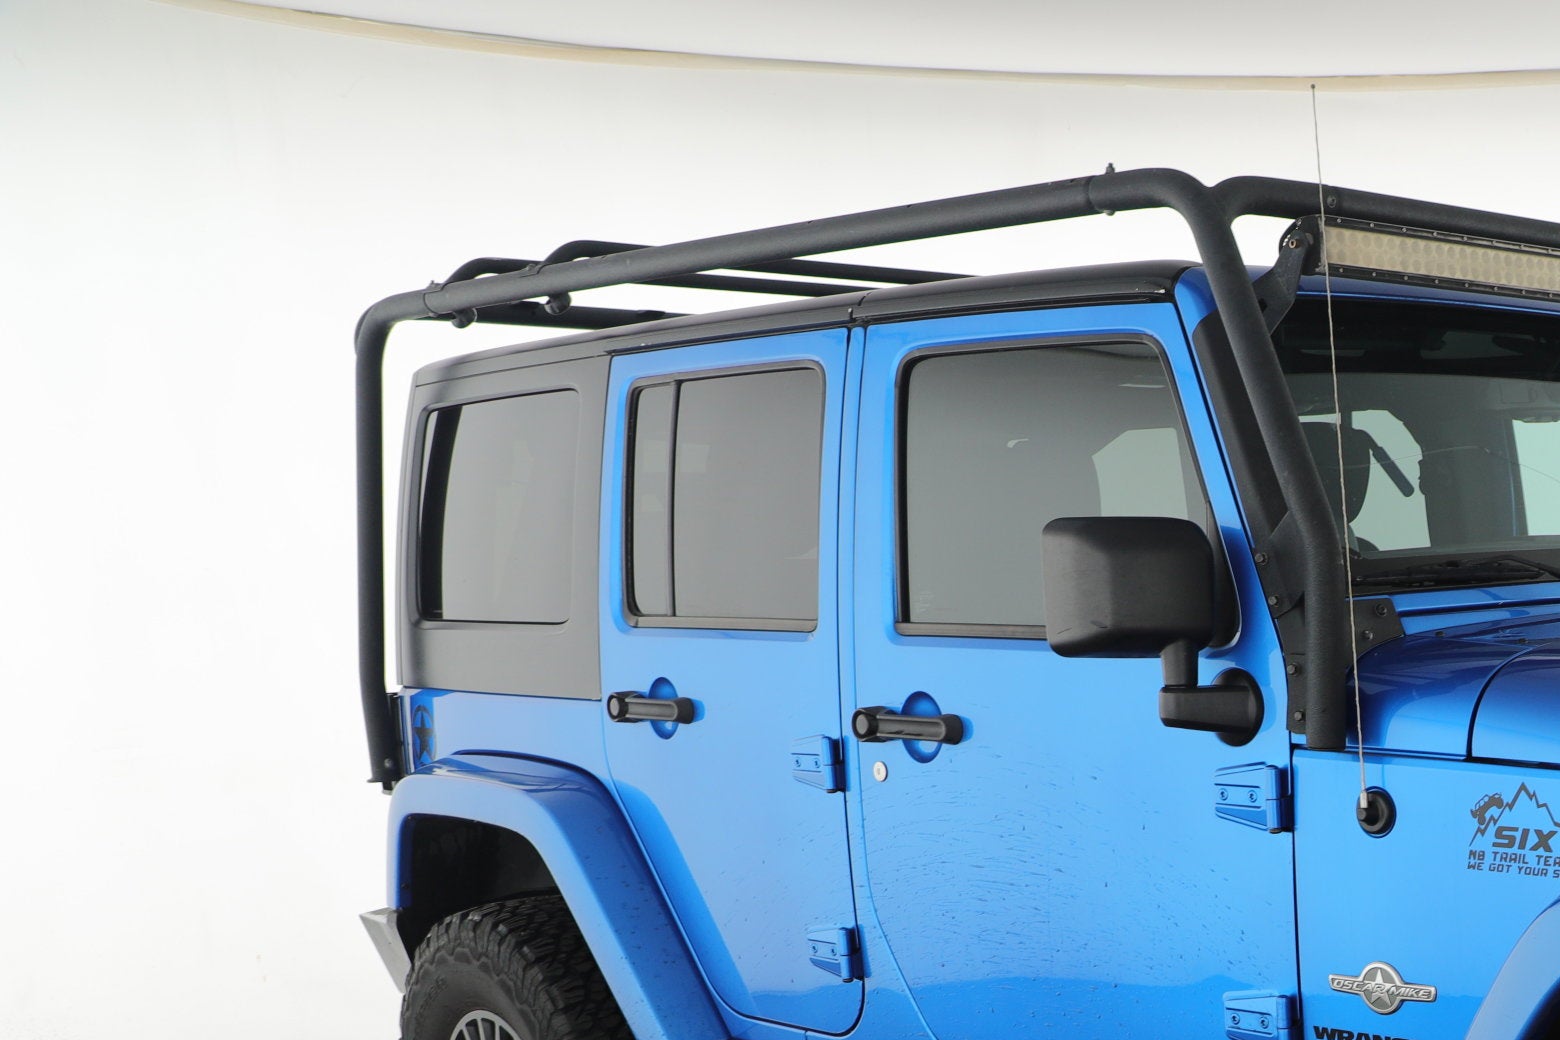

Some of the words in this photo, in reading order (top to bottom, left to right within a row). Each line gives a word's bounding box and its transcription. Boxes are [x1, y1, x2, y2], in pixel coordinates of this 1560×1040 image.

[1492, 826, 1558, 853] SIX
[1491, 851, 1529, 865] TRAIL
[1467, 861, 1485, 871] WE
[1488, 863, 1512, 874] GOT
[1517, 865, 1549, 878] YOUR
[1333, 980, 1387, 994] OSCAR
[1388, 985, 1431, 998] MIKE
